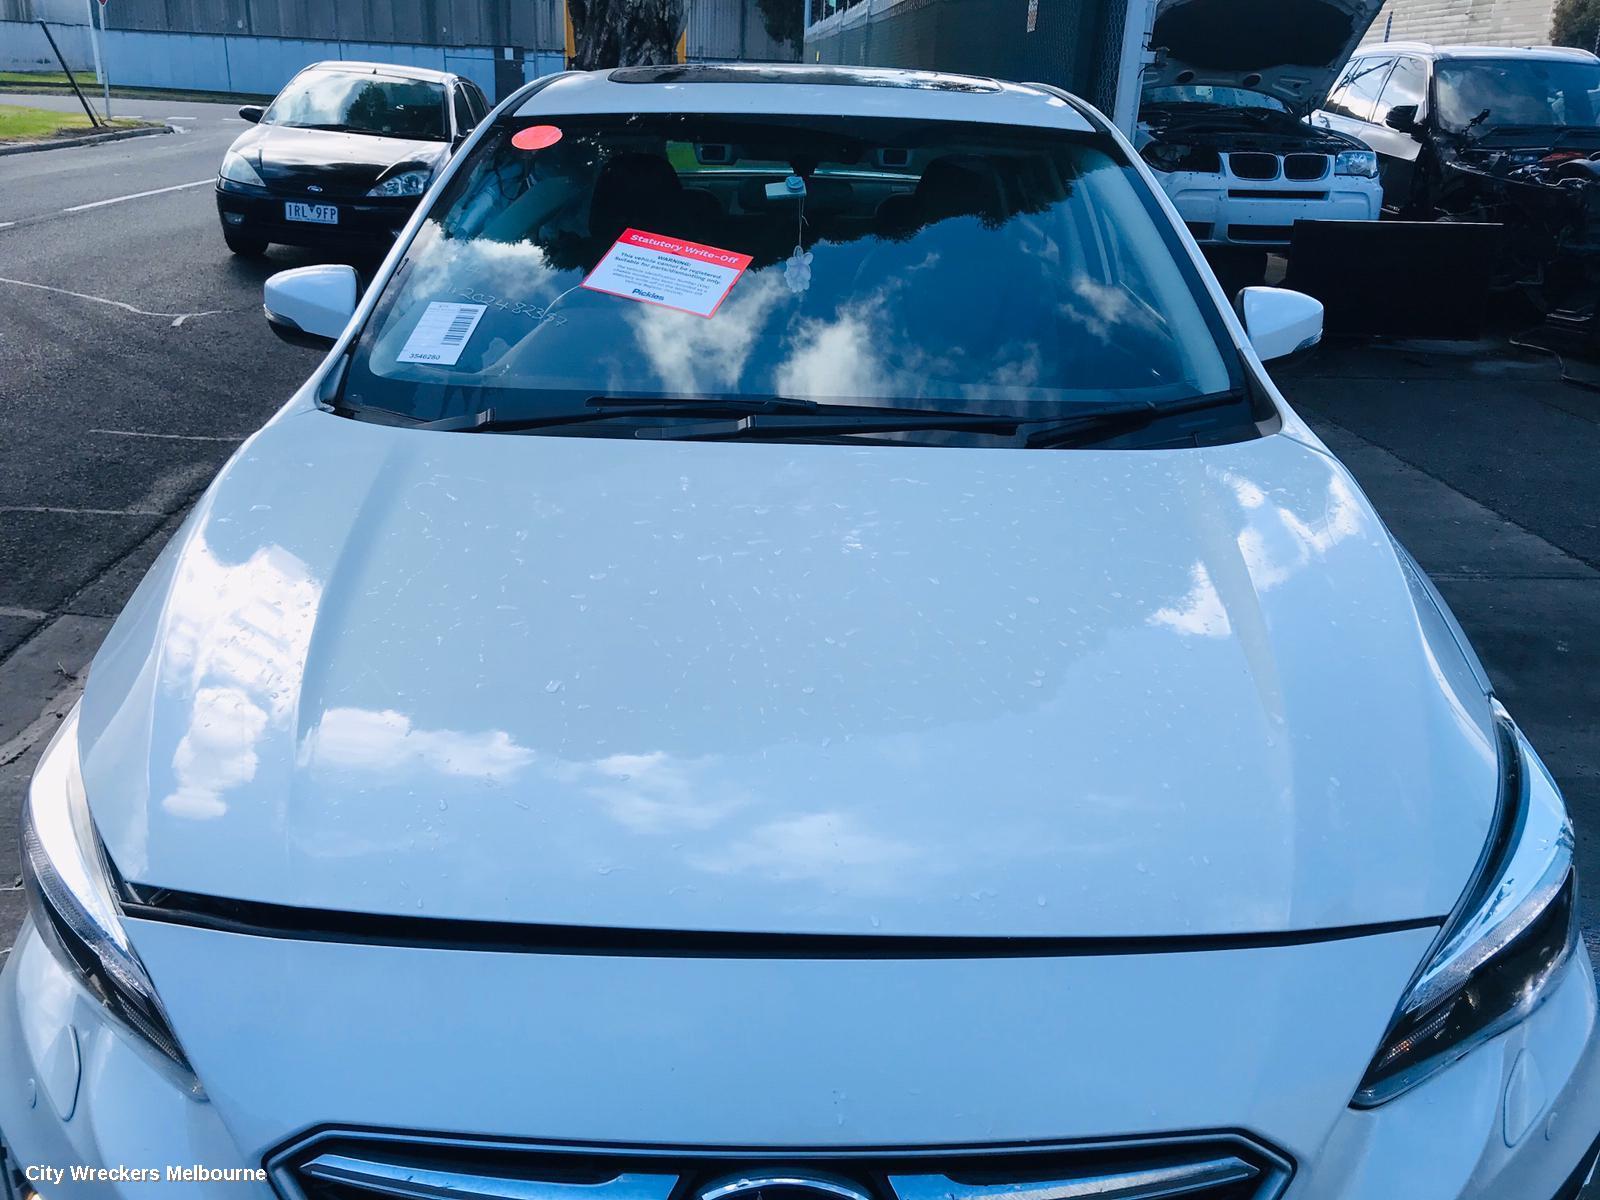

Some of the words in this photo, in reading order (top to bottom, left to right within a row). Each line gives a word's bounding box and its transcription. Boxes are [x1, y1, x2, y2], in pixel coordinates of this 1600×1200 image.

[288, 204, 308, 217] 1RL
[316, 206, 337, 219] 9FP
[630, 234, 683, 251] Statutory
[684, 246, 739, 263] Write-Off
[631, 288, 666, 300] Pickles
